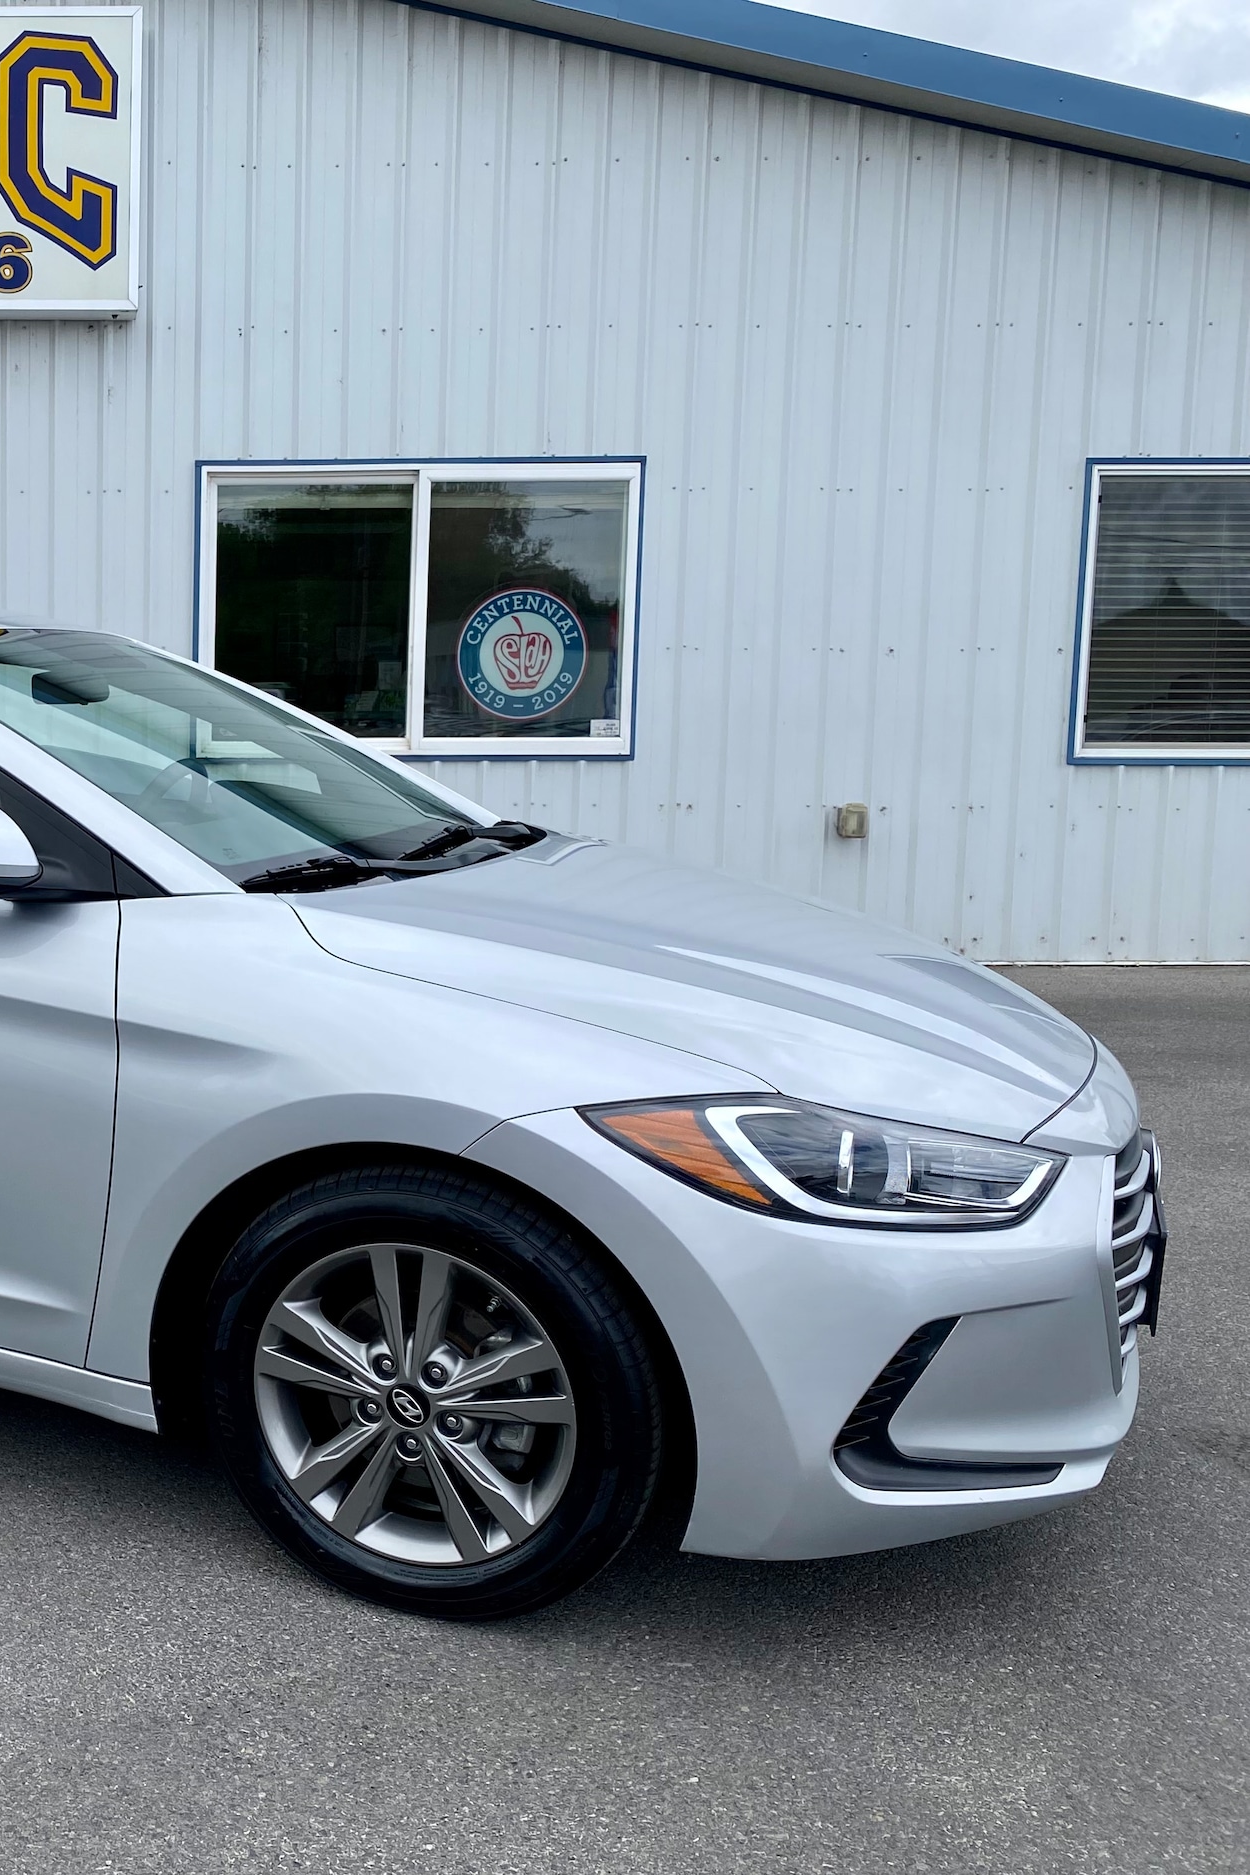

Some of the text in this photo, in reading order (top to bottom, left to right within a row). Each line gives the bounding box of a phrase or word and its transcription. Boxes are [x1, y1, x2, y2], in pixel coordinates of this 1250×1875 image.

[466, 594, 578, 645] CENTENNIAL
[468, 672, 506, 709] 1919
[531, 672, 573, 711] 2019
